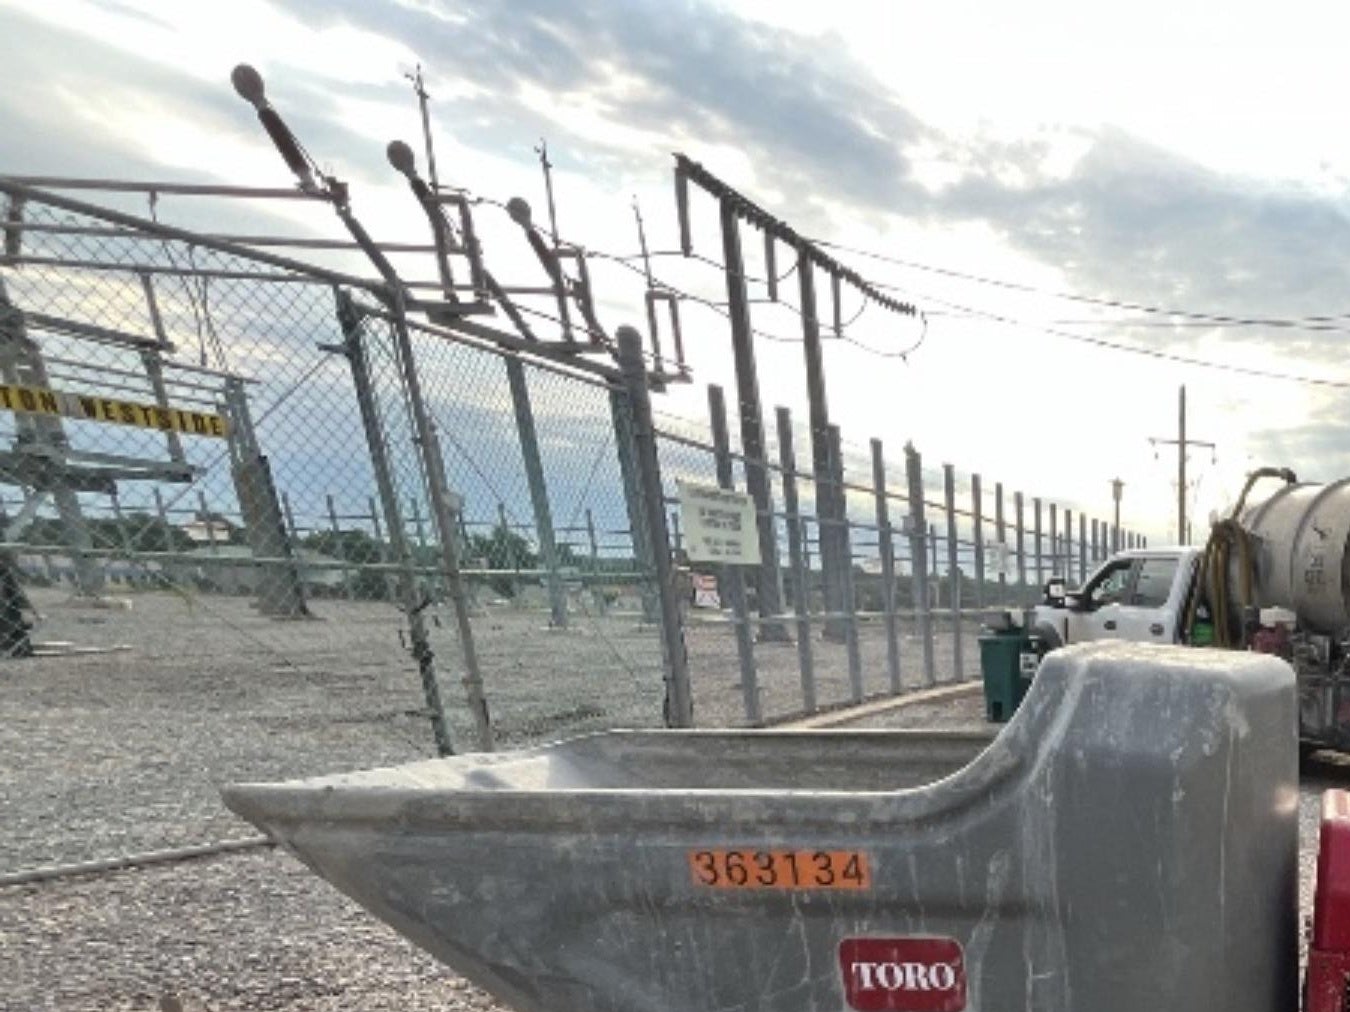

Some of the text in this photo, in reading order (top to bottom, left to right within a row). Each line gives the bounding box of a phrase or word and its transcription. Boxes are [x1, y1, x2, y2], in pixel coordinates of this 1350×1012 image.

[80, 397, 223, 435] WESTSIDE
[695, 851, 864, 886] 363134
[851, 961, 955, 991] TORO
